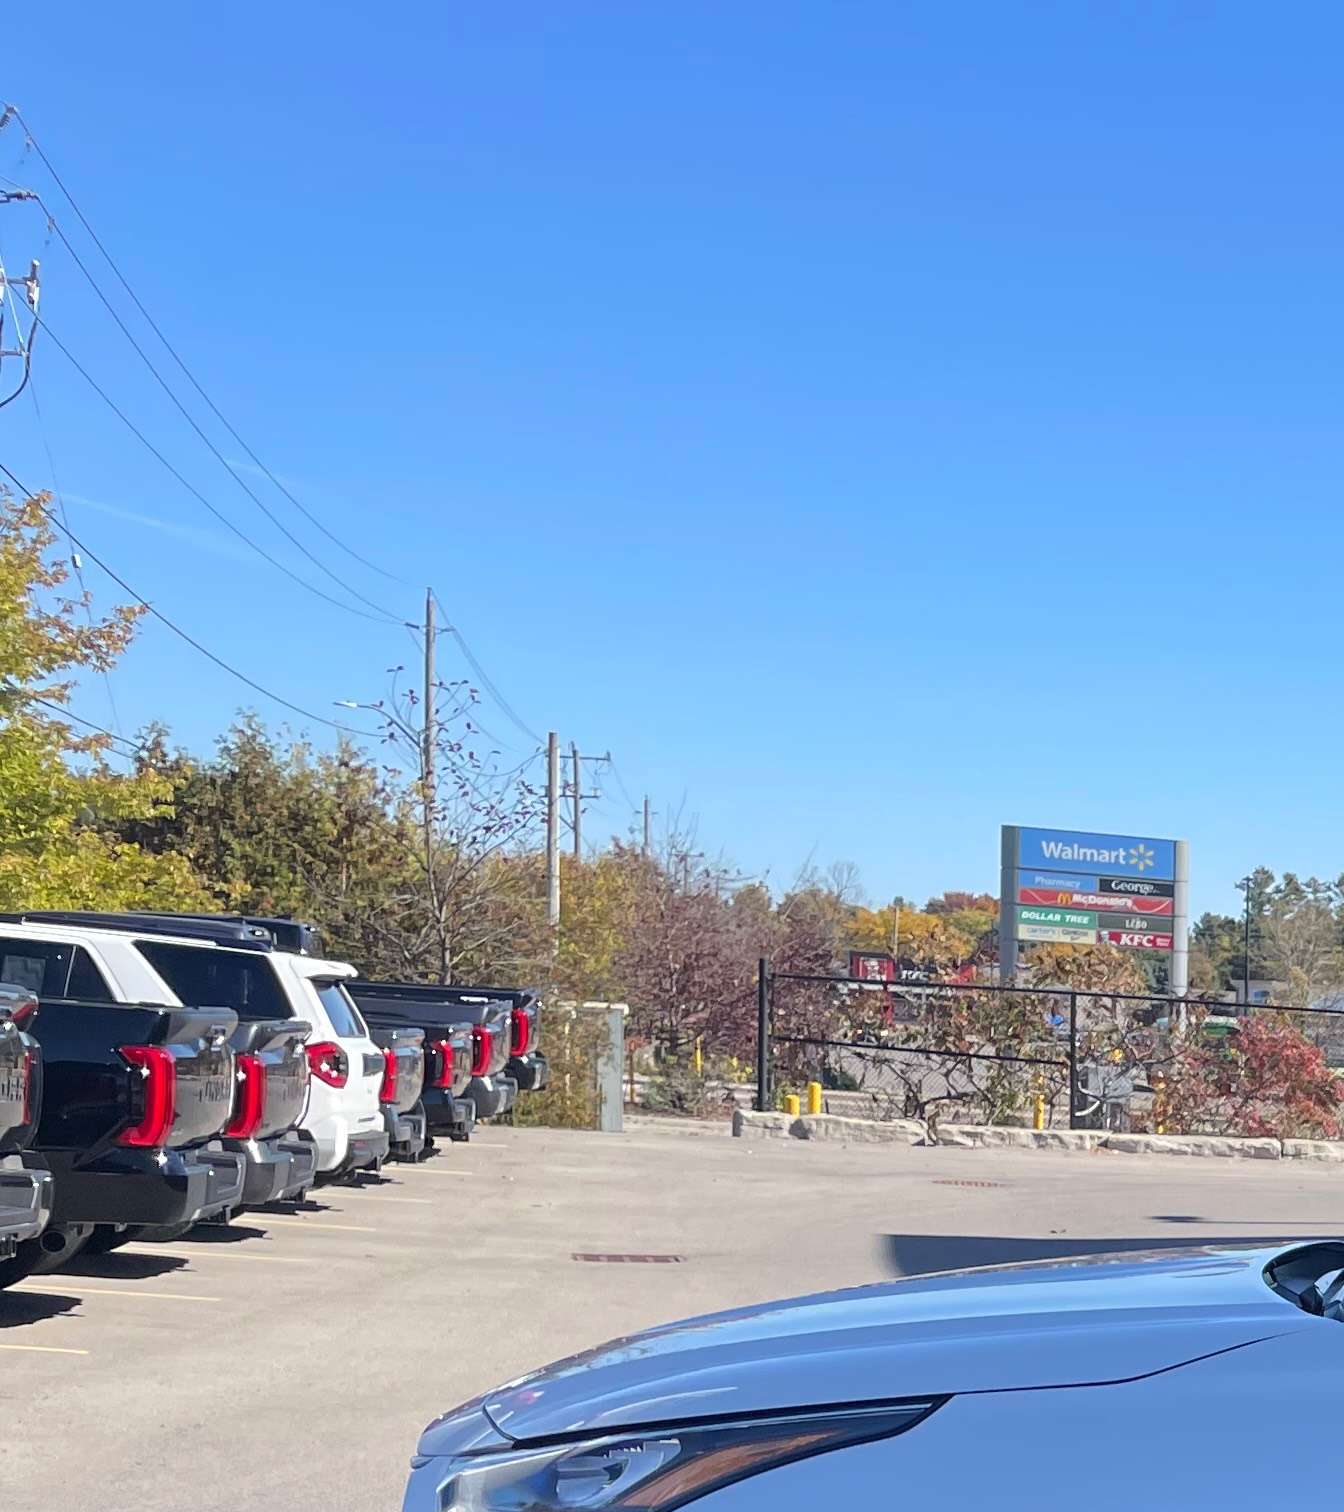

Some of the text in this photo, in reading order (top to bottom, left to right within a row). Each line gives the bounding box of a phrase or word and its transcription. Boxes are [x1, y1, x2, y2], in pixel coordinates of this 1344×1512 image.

[1041, 840, 1127, 865] Walmart
[1034, 876, 1081, 889] Pharmacy
[1111, 880, 1154, 896] George
[1021, 911, 1090, 925] DOLLAR TREE
[1120, 933, 1154, 947] KFC
